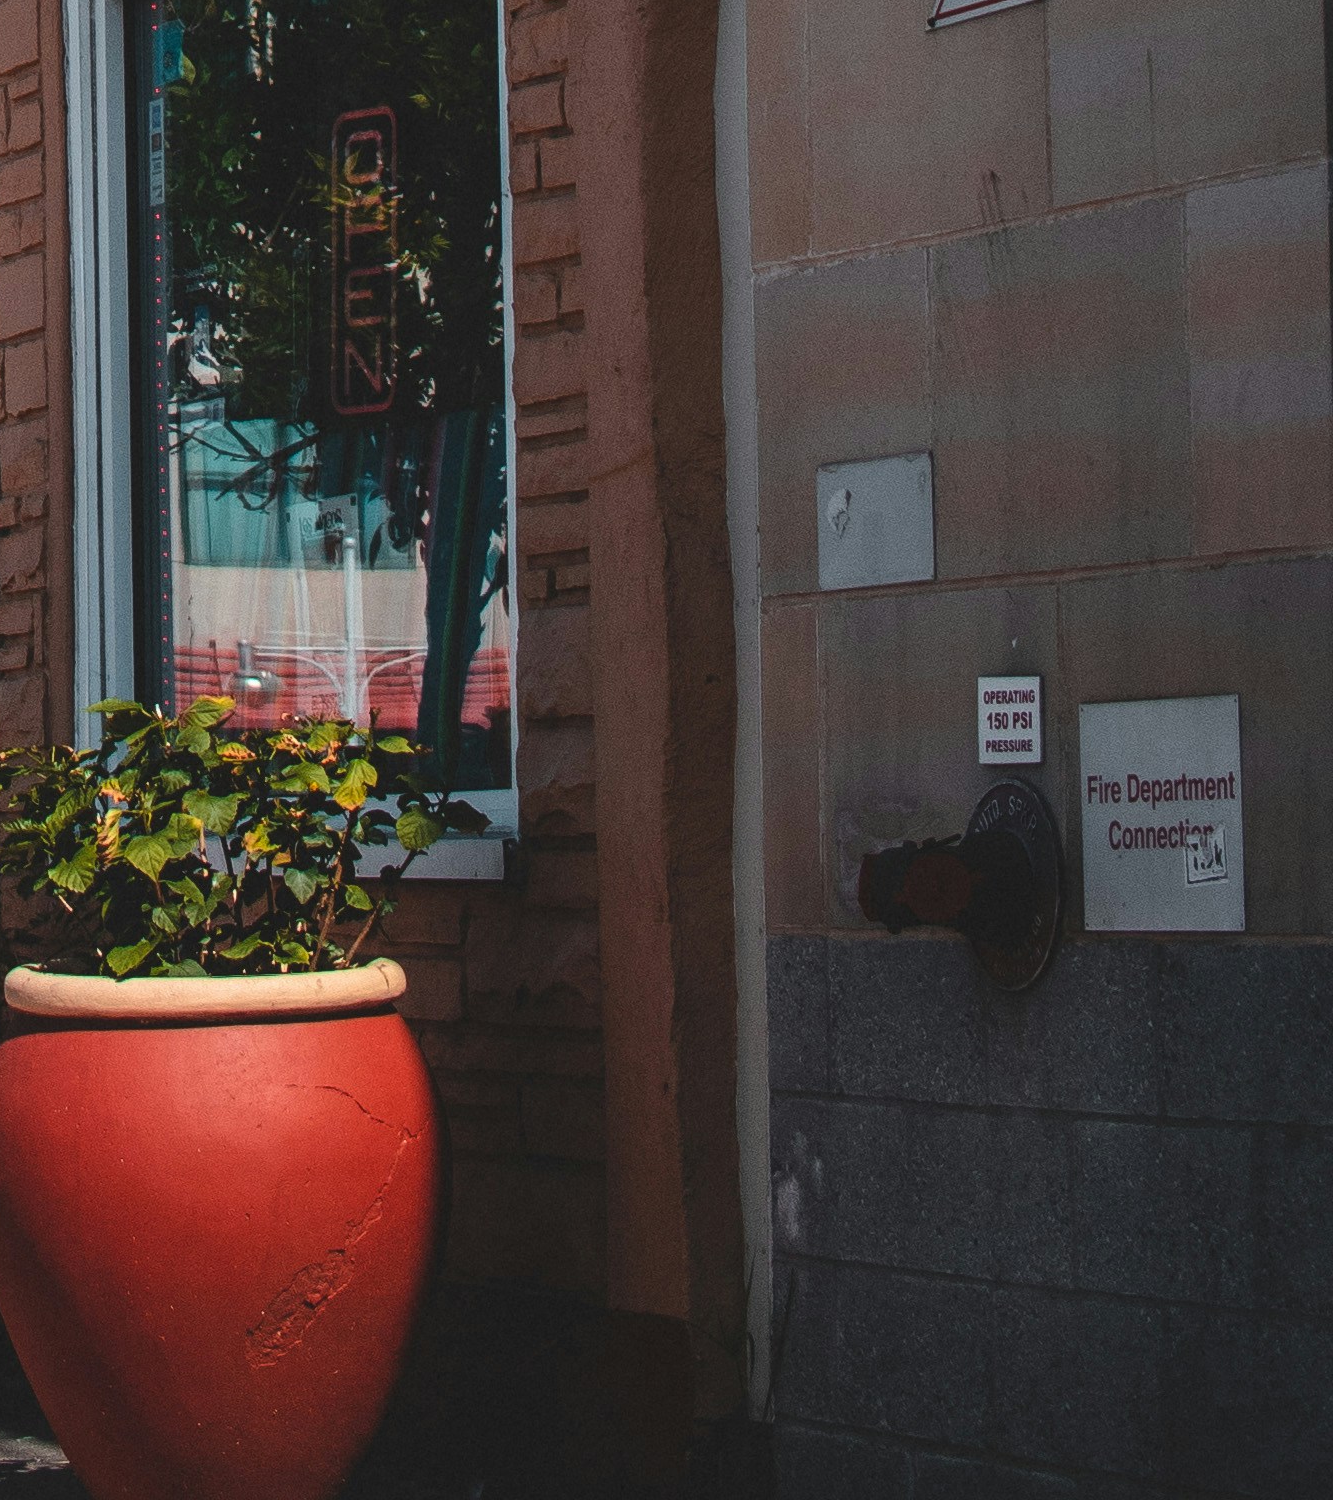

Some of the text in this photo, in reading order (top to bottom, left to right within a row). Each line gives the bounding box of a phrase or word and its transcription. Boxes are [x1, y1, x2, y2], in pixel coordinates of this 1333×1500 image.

[983, 689, 1035, 705] OPERATING
[986, 711, 1033, 730] 150 PSI
[985, 738, 1033, 753] PRESSURE
[1087, 771, 1236, 810] Fire Department
